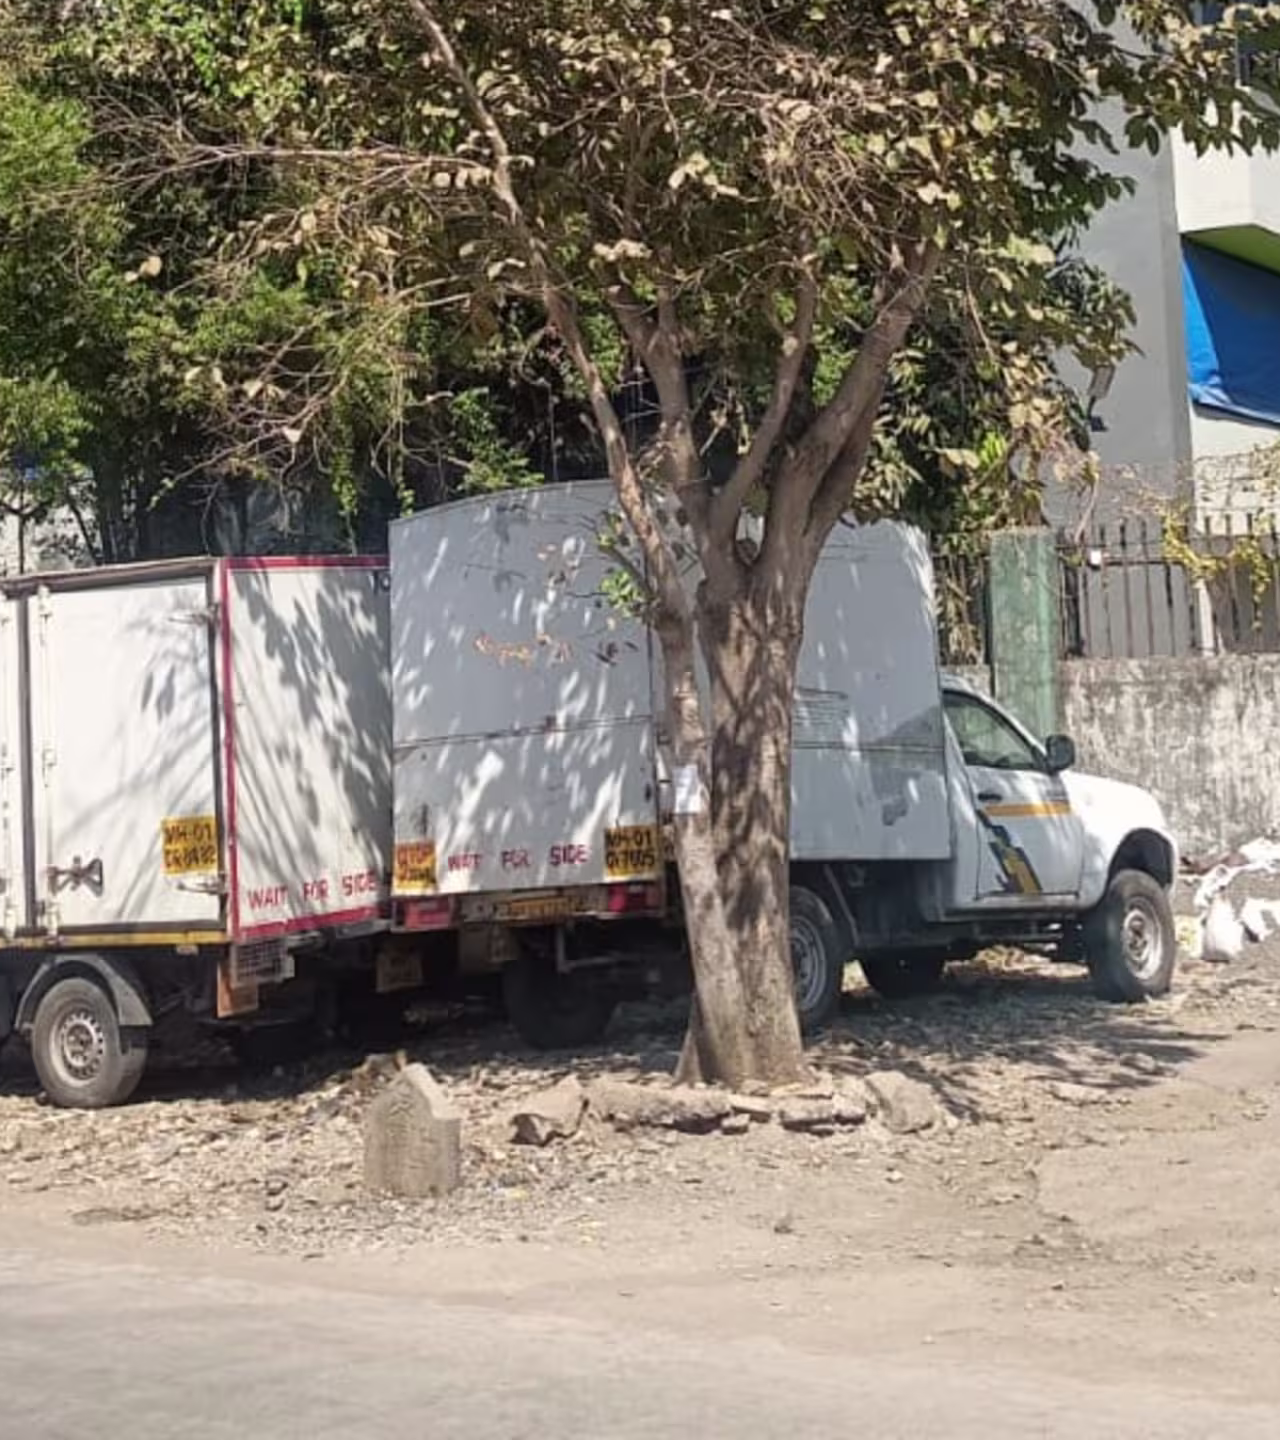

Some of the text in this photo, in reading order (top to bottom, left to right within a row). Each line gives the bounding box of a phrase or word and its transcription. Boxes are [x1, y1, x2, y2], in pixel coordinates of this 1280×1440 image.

[502, 849, 529, 867] FOR
[550, 844, 589, 867] SIDE
[248, 885, 287, 910] WAIT
[303, 879, 329, 902] FOR
[341, 870, 376, 896] SIDE
